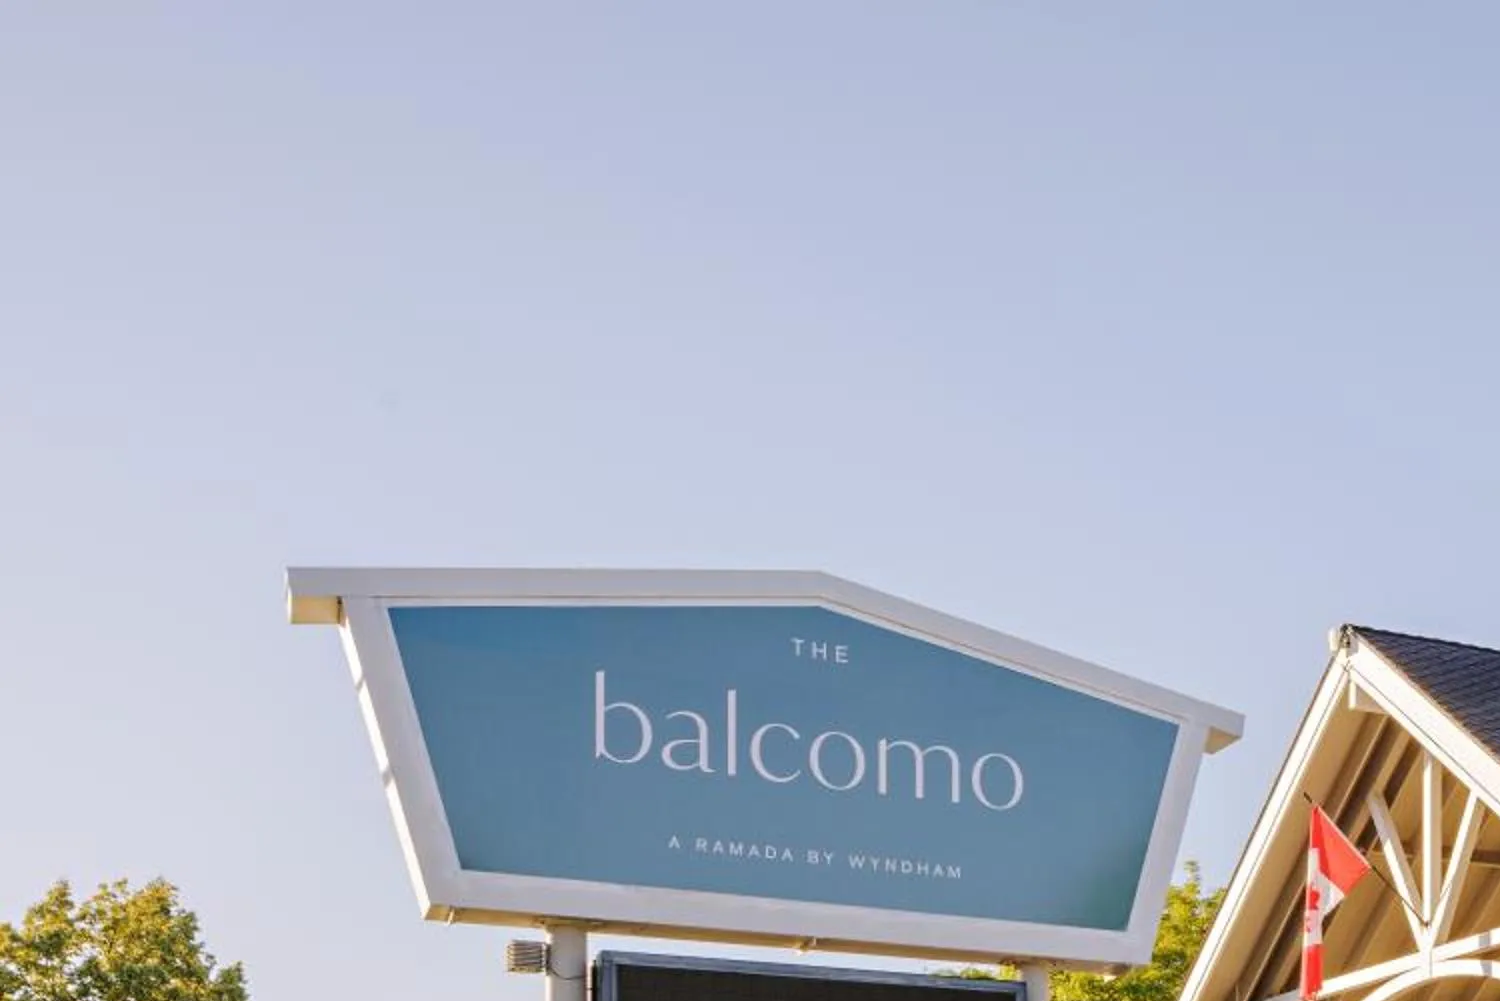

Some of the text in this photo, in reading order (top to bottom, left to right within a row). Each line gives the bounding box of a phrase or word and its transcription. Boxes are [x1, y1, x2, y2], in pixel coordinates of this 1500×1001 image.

[791, 637, 849, 664] THE
[594, 669, 1025, 811] balcomo
[667, 834, 963, 880] A RAMADA BY WYNDHAM
